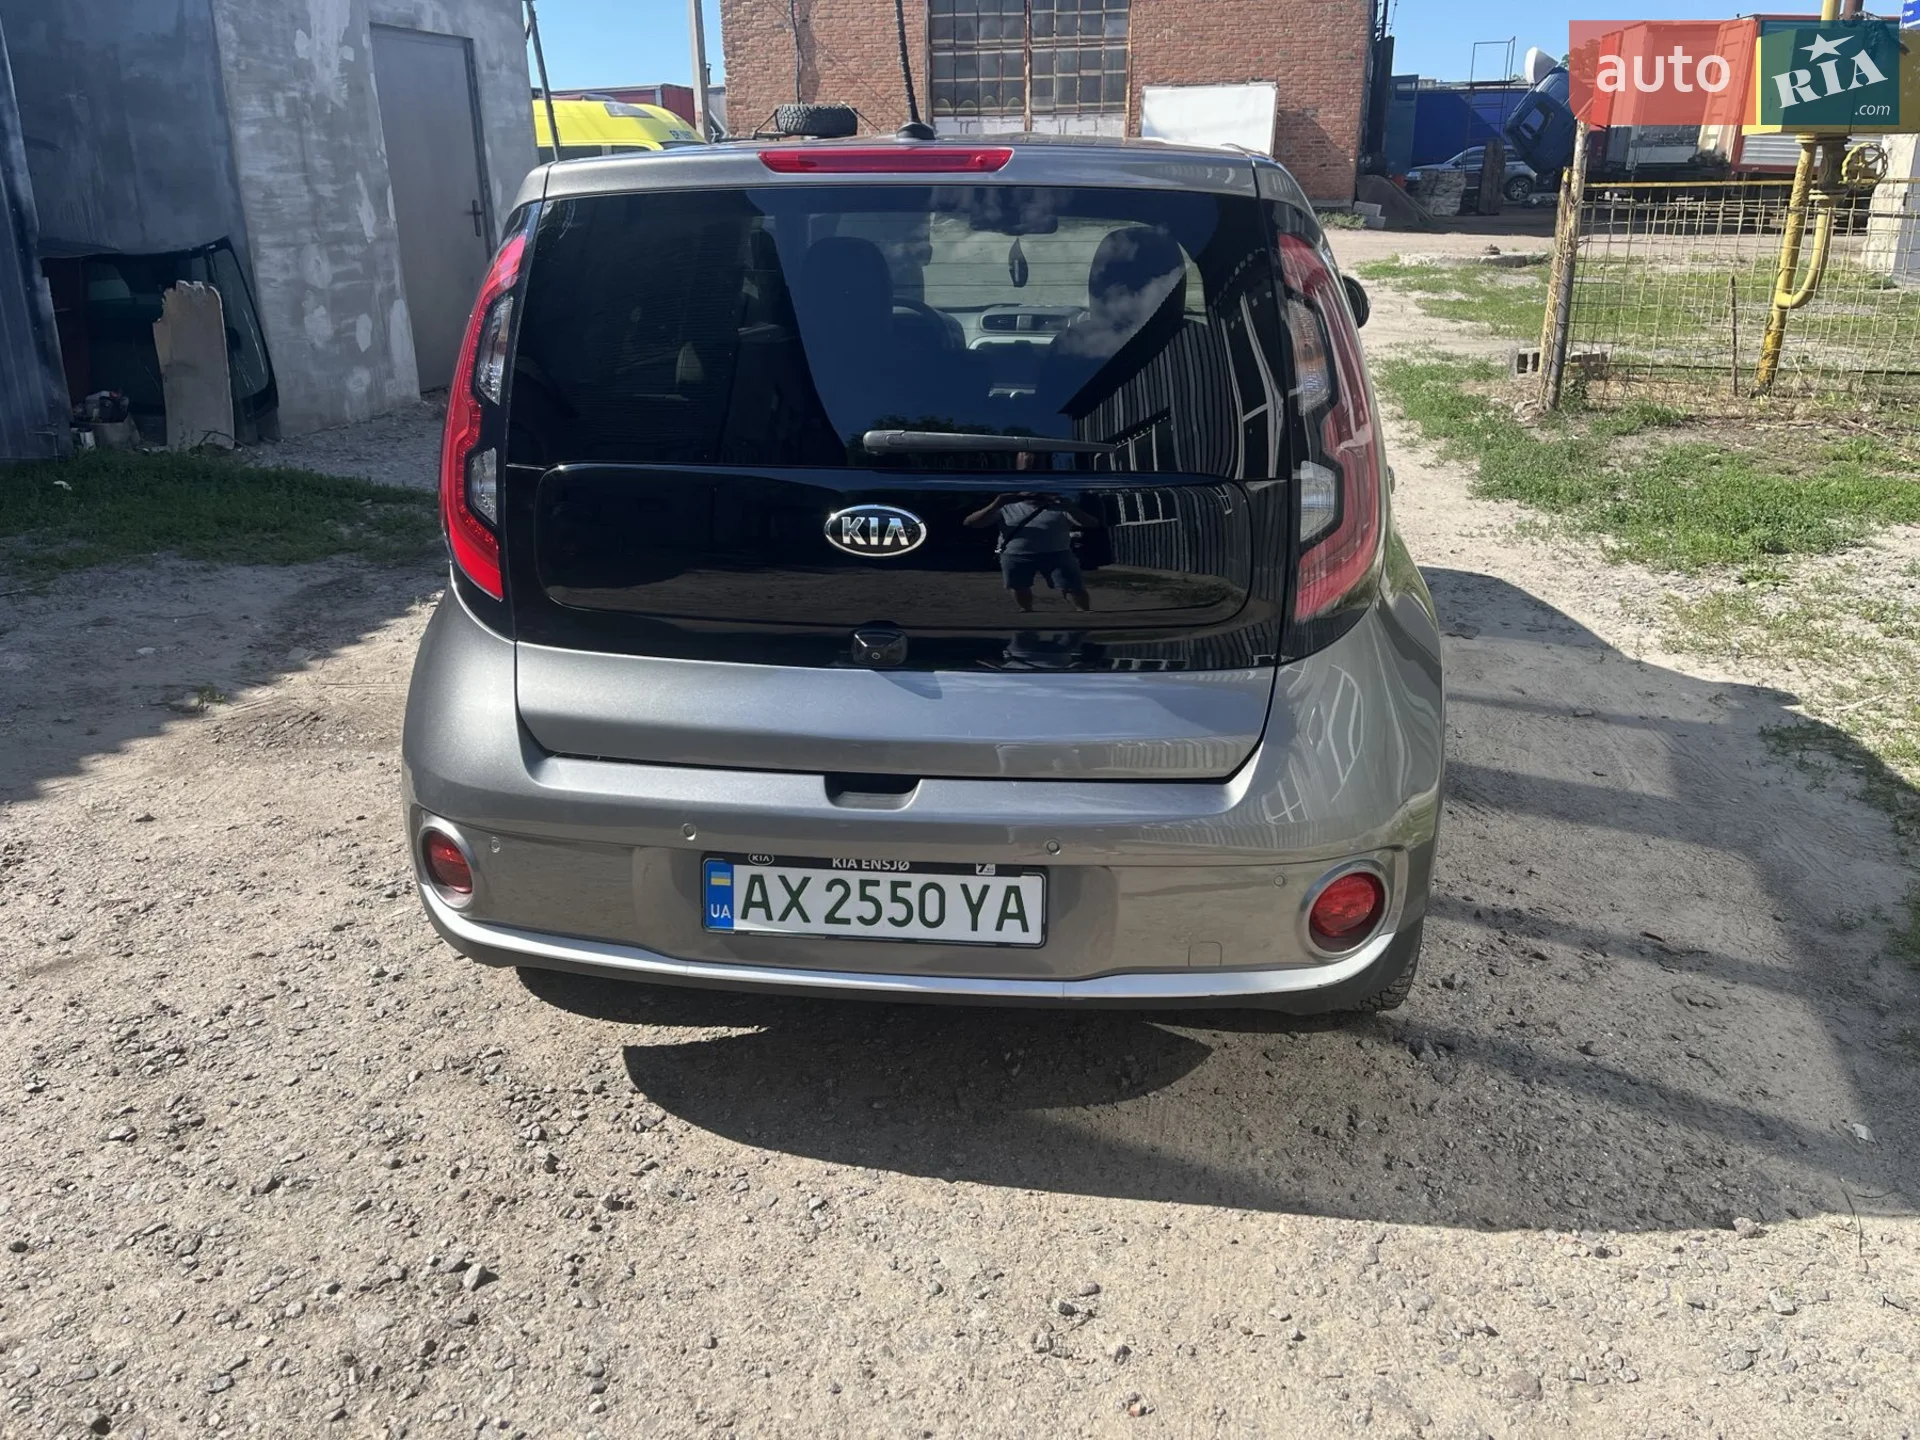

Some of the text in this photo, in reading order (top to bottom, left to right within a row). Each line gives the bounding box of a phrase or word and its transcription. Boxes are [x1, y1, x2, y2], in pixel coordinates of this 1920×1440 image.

[841, 516, 909, 546] KIA
[752, 854, 770, 862] KIA
[832, 858, 910, 872] KIA ENSJØ
[740, 874, 1029, 933] AX 2550 YA
[711, 904, 731, 919] UA
